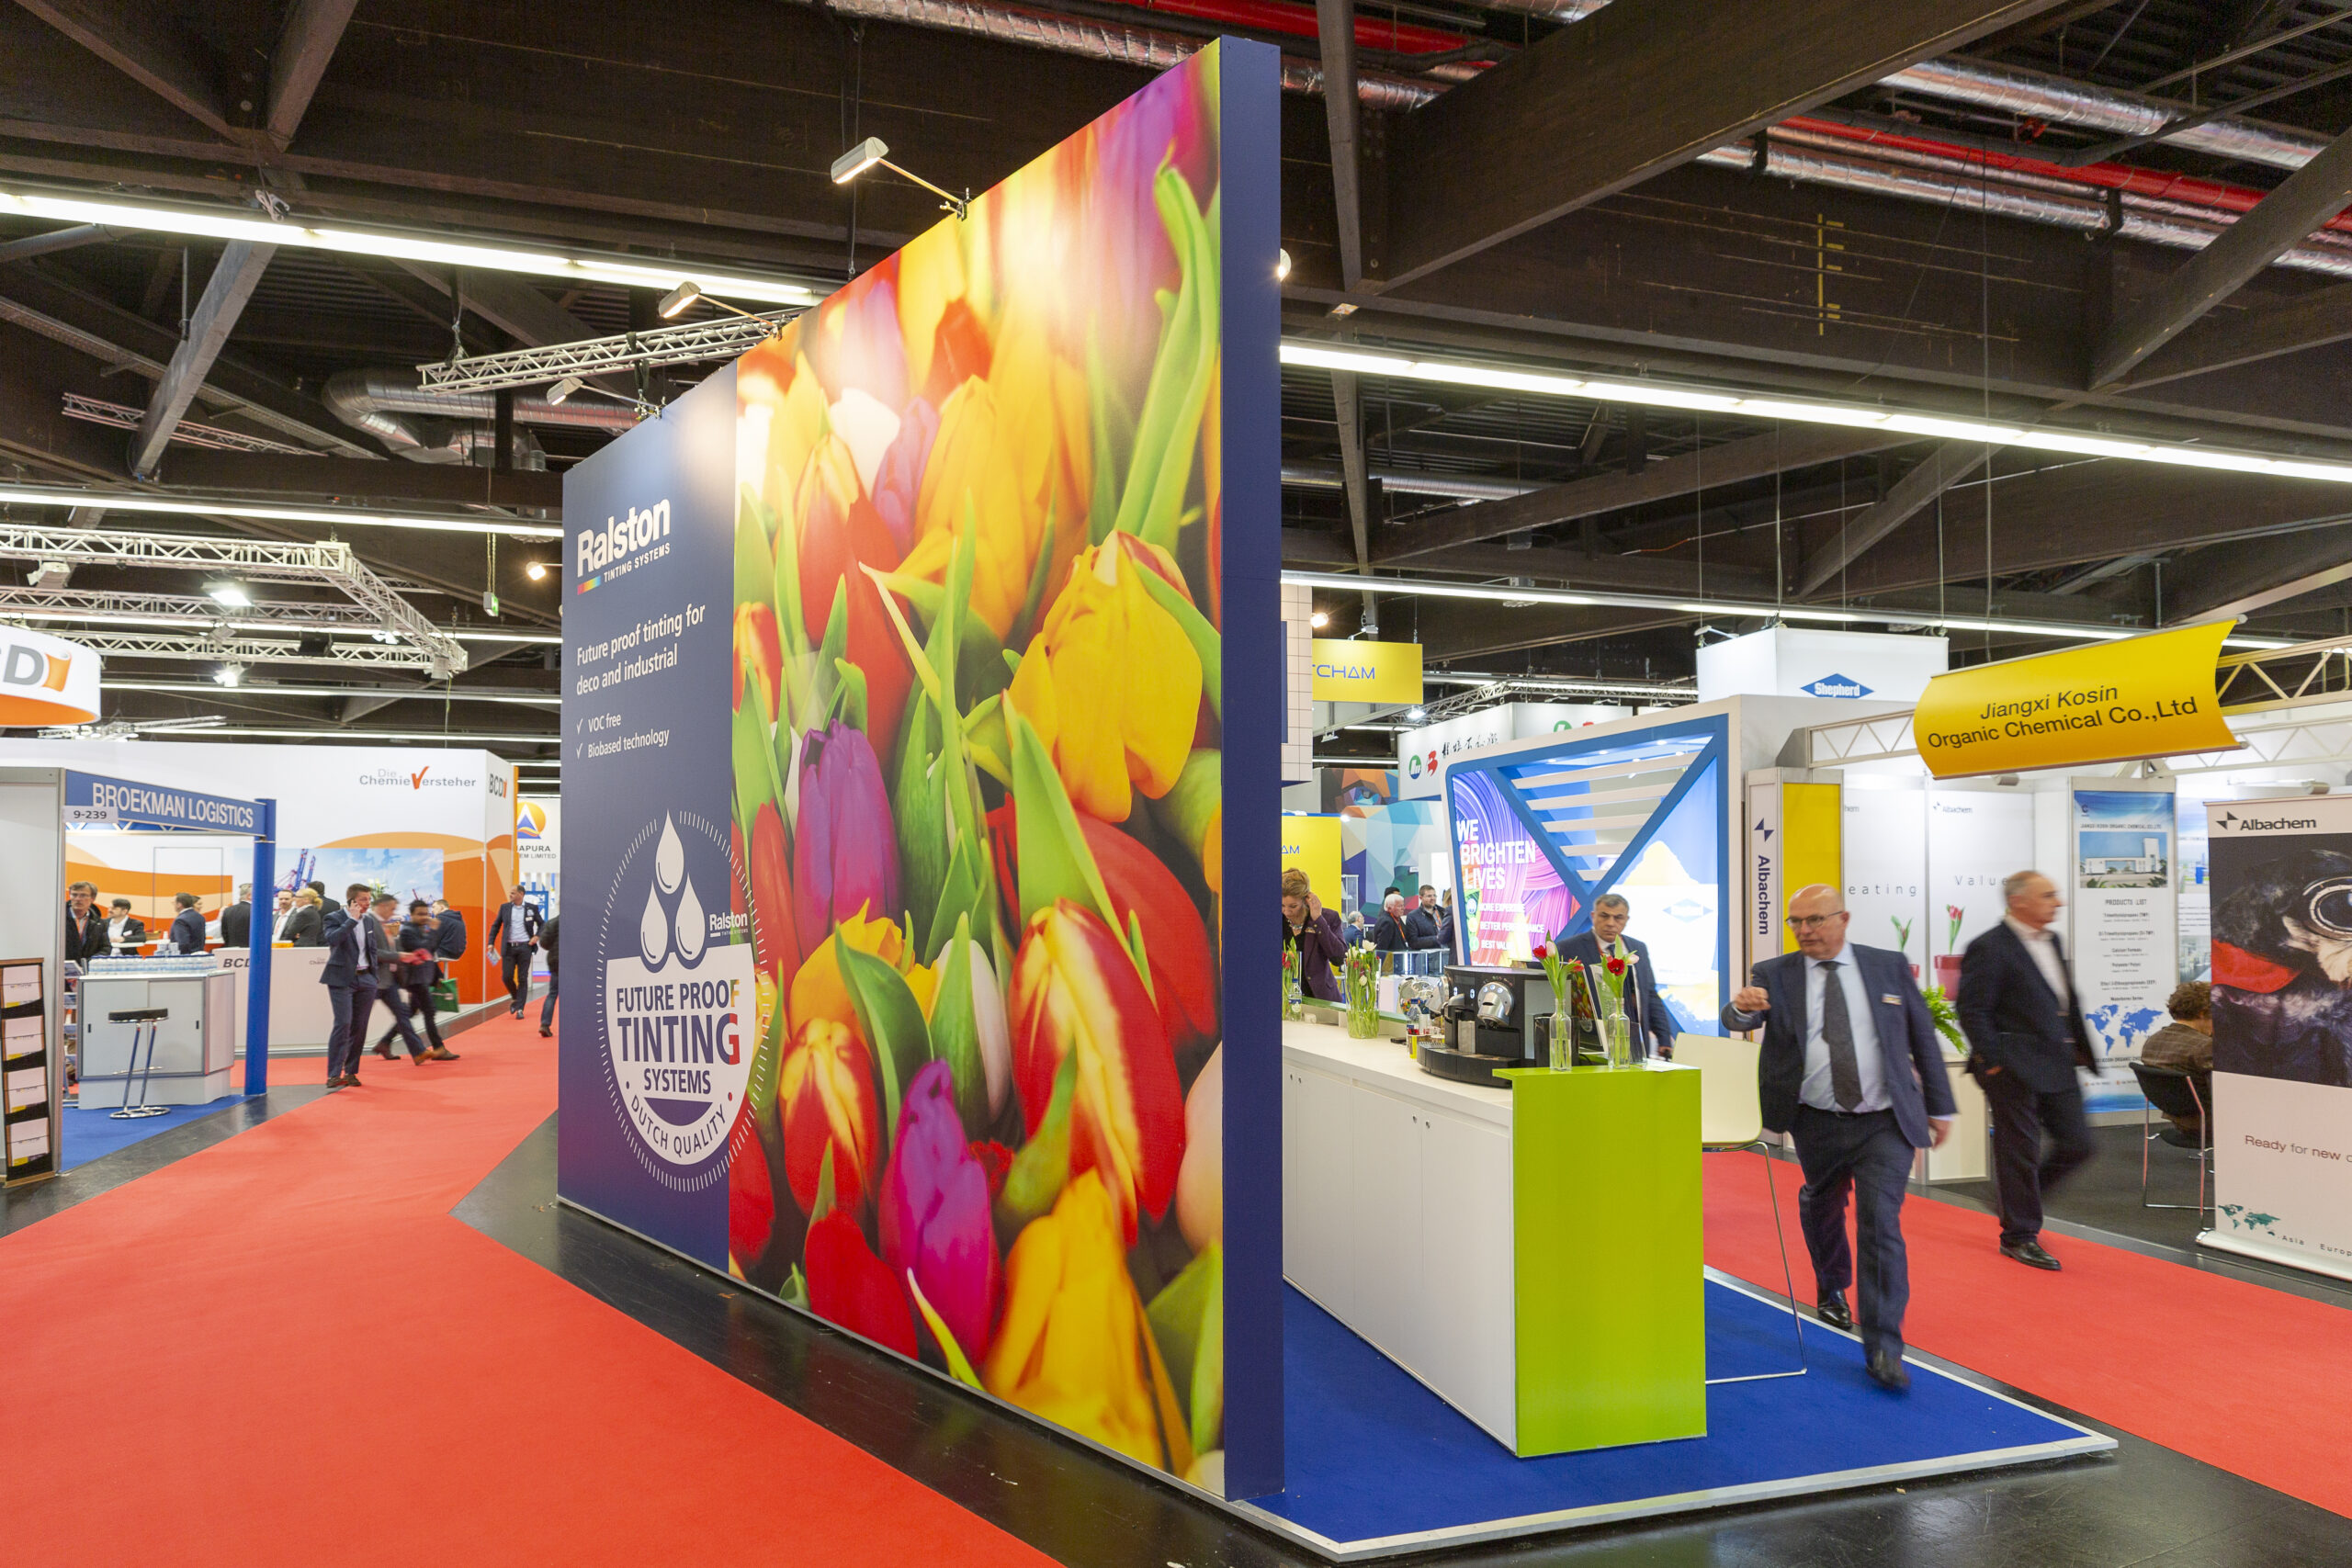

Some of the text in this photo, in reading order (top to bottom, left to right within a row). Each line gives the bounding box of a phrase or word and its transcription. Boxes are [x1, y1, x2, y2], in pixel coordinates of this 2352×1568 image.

[577, 499, 670, 578] Ralston
[604, 542, 670, 582] TINTING SYSTEMS
[577, 603, 706, 666] Future proof tinting for
[0, 644, 44, 686] D
[576, 643, 678, 695] deco and industrial
[1312, 663, 1375, 680] CHAM
[1815, 682, 1860, 697] Shepherd
[1980, 685, 2118, 719] Jiangxi Kosin
[588, 713, 621, 732] VOC free
[1928, 696, 2199, 749] Organic Chemical Co.,Ltd
[588, 728, 670, 758] Biobased technology
[378, 768, 397, 778] Die
[73, 810, 107, 819] 9-239
[92, 783, 254, 829] BROEKMAN LOGISTICS
[1456, 819, 1478, 841] WE
[2240, 818, 2317, 830] Albachem
[1282, 845, 1300, 854] AM
[1460, 840, 1536, 865] BRIGHTEN
[1464, 867, 1506, 890] LIVES
[1849, 885, 1917, 897] eating
[1758, 854, 1770, 935] Albachem
[709, 911, 748, 931] Ralston
[1480, 921, 1501, 931] BETTER
[1481, 940, 1496, 949] BEST
[616, 978, 741, 1012] FUTURE PROOF
[617, 1012, 741, 1066] TINTING
[644, 1067, 711, 1094] SYSTEMS
[631, 1094, 726, 1158] DUTCH QUALITY
[2245, 1135, 2286, 1153] Ready
[2290, 1143, 2308, 1155] for
[2312, 1148, 2341, 1160] new
[2282, 1235, 2352, 1257] Asia Europ
